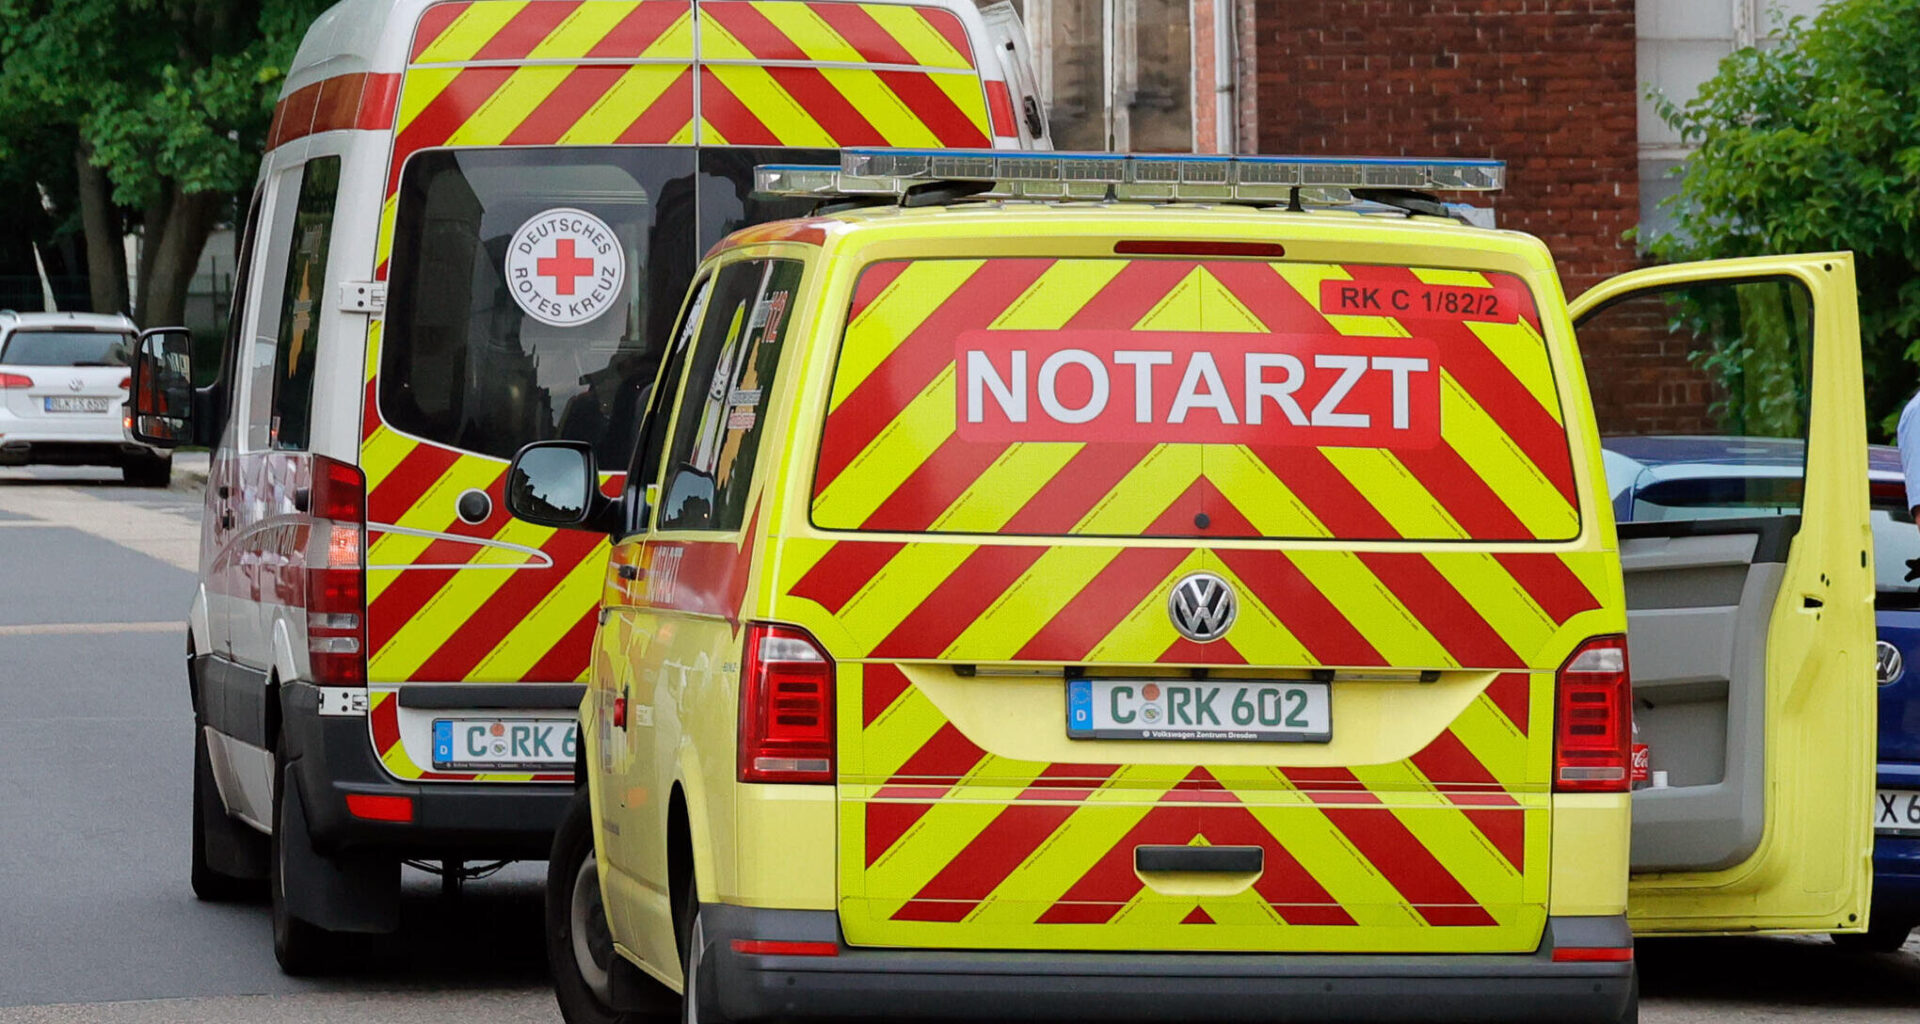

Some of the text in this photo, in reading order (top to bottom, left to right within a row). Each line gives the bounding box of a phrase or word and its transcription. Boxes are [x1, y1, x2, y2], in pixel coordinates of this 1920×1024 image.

[519, 218, 611, 255] DEUTSCHES
[514, 266, 615, 317] ROTES KREUZ
[1341, 287, 1498, 316] RK C 1/82/2
[967, 349, 1428, 430] NOTARZT
[1077, 686, 1309, 728] D C RK 602
[440, 745, 448, 755] D
[467, 726, 487, 757] C
[512, 726, 553, 757] RK
[1152, 731, 1195, 739] Volkswagen
